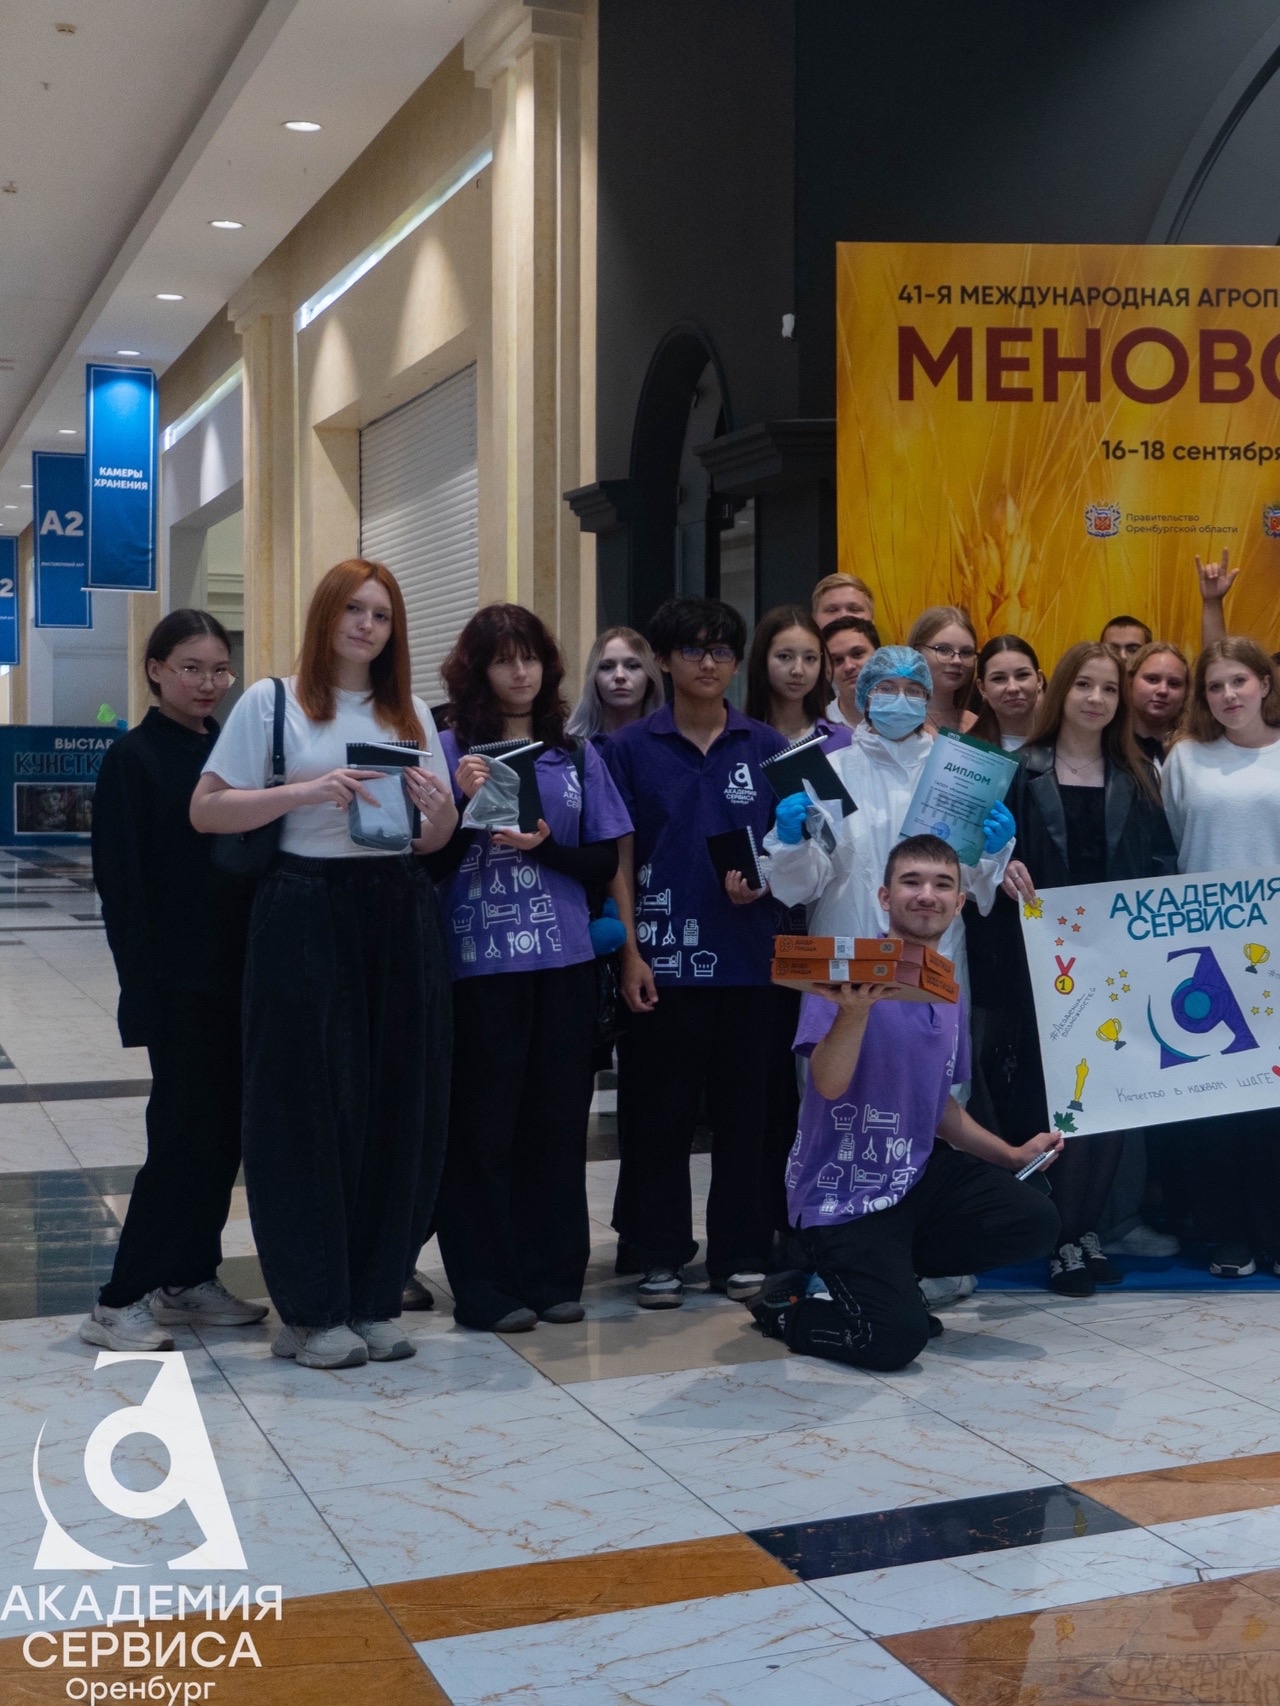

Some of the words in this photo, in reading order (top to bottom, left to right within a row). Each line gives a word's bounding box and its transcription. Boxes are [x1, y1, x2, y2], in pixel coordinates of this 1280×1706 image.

[898, 285, 952, 306] 41-Я
[959, 286, 1190, 309] МЕЖДУНАРОДНАЯ
[1101, 440, 1166, 462] 16-18
[99, 466, 143, 479] КАМЕРЫ
[94, 478, 148, 490] ХРАНЕНИЯ
[40, 510, 84, 537] А2
[1125, 513, 1200, 524] Правительство
[1125, 524, 1197, 535] Оренбургской
[1199, 525, 1238, 534] области
[943, 762, 992, 786] ДИПЛОМ
[1127, 902, 1268, 940] СЕРВИСА
[881, 943, 893, 952] 30
